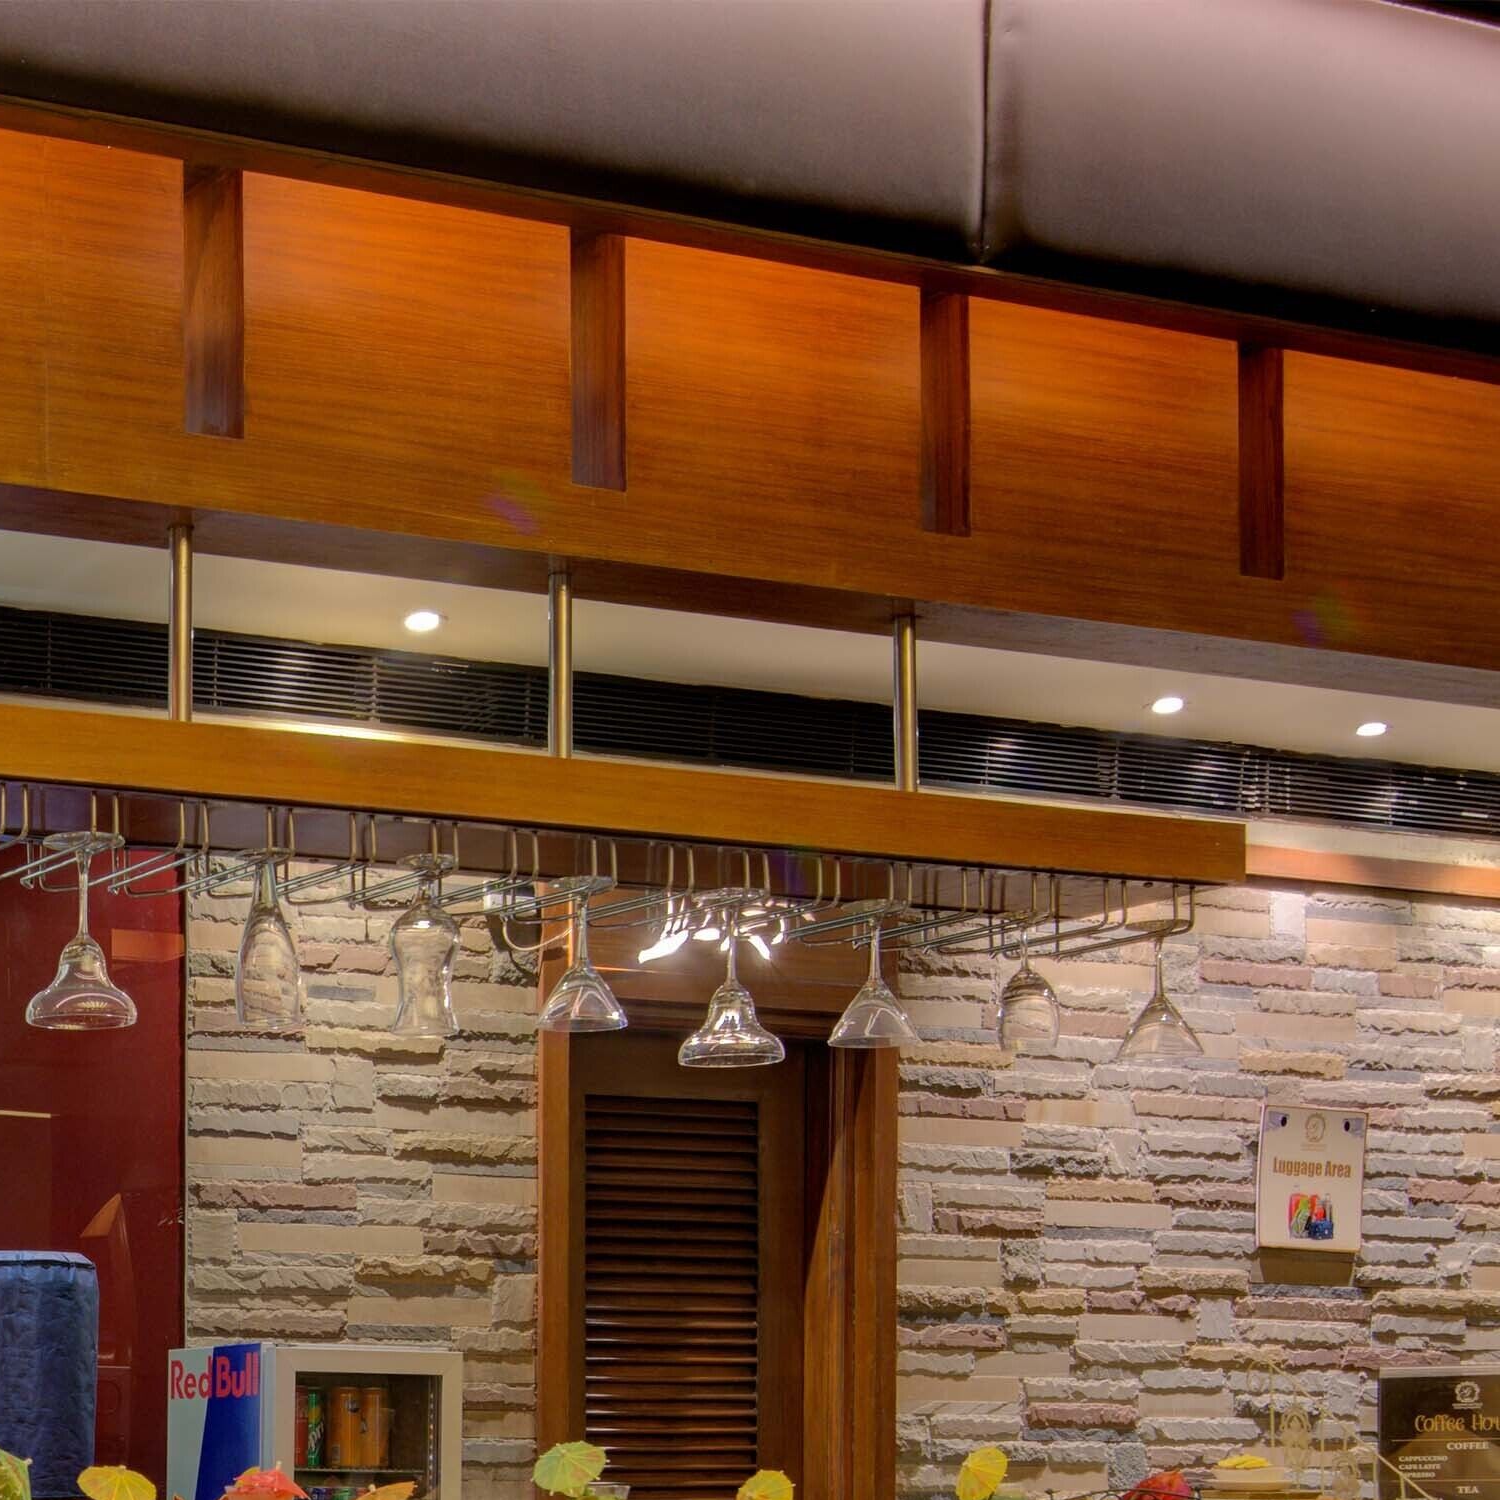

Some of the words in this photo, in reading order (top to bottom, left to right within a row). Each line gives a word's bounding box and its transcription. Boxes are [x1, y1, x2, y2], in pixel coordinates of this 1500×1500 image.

[1273, 1156, 1323, 1177] Luggage
[1325, 1161, 1352, 1178] Area
[171, 1354, 212, 1400] Red
[216, 1352, 259, 1398] Bull
[1415, 1414, 1465, 1432] Coffee
[1446, 1441, 1489, 1450] COFFEE
[1457, 1486, 1479, 1494] TEA
